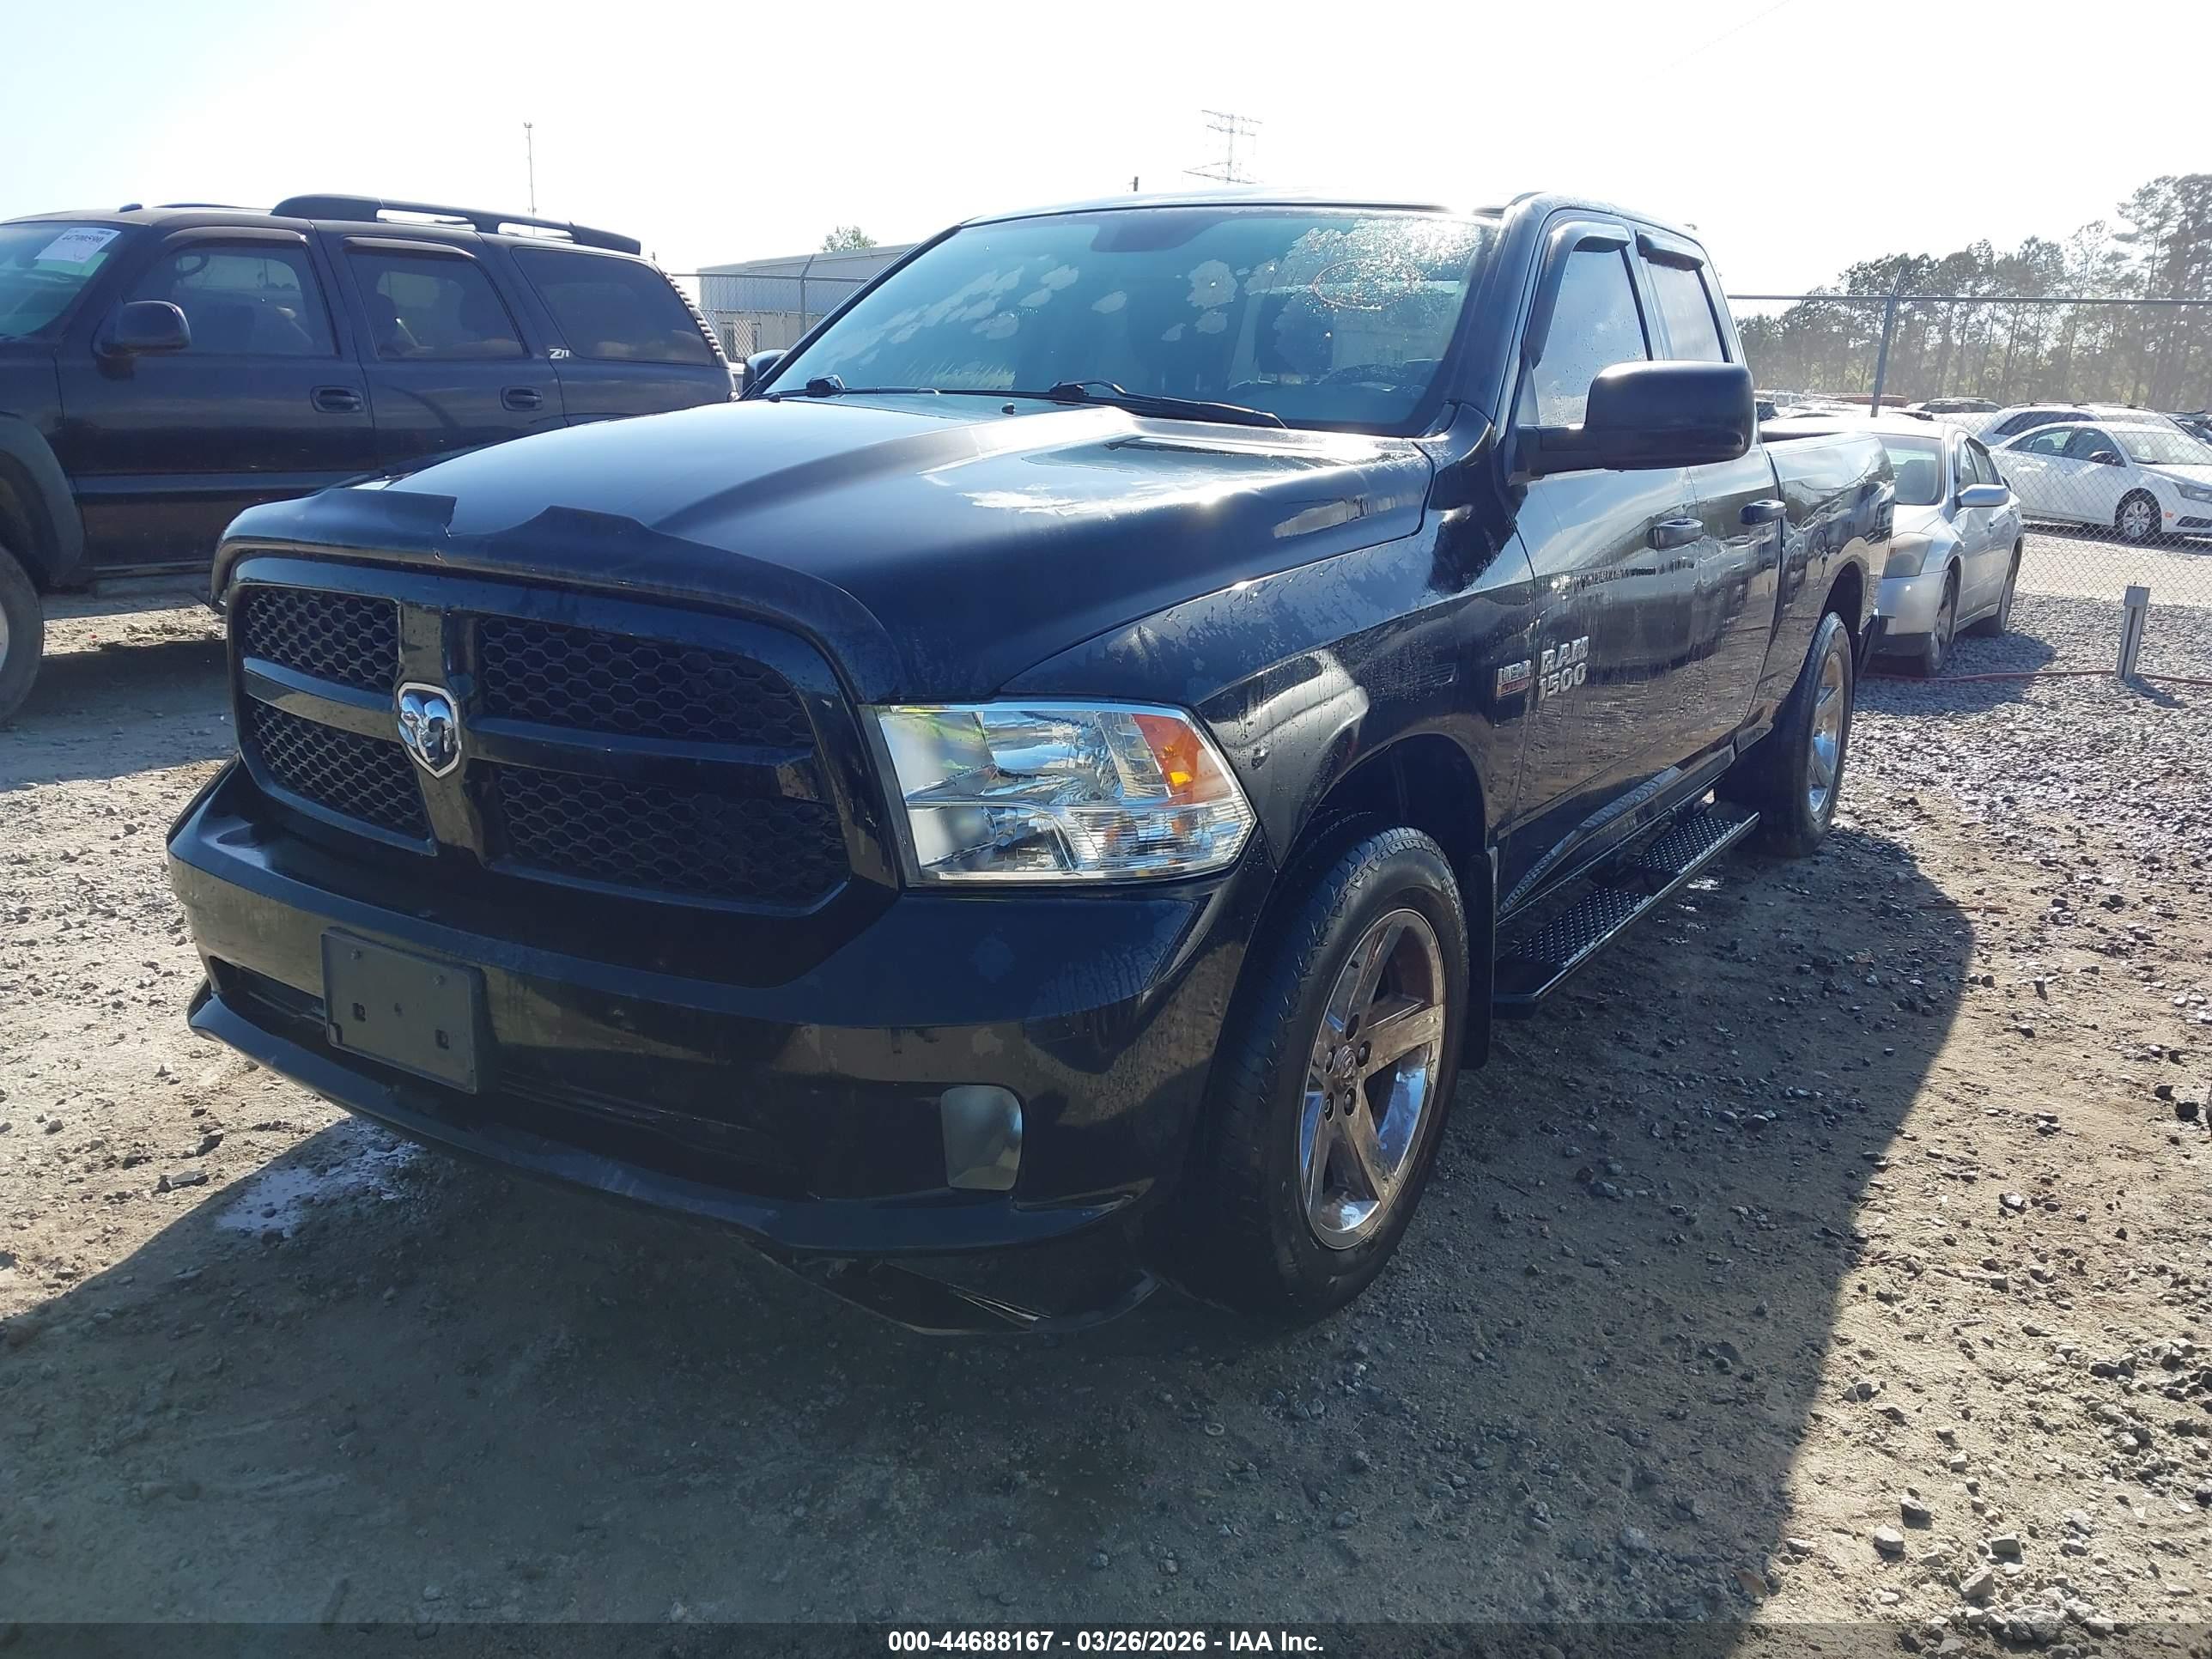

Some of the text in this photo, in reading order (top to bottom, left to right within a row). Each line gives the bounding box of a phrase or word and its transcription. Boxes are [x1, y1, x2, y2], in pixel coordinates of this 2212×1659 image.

[549, 348, 571, 359] Z71
[1540, 635, 1589, 675] RAM
[1538, 662, 1588, 702] 1500
